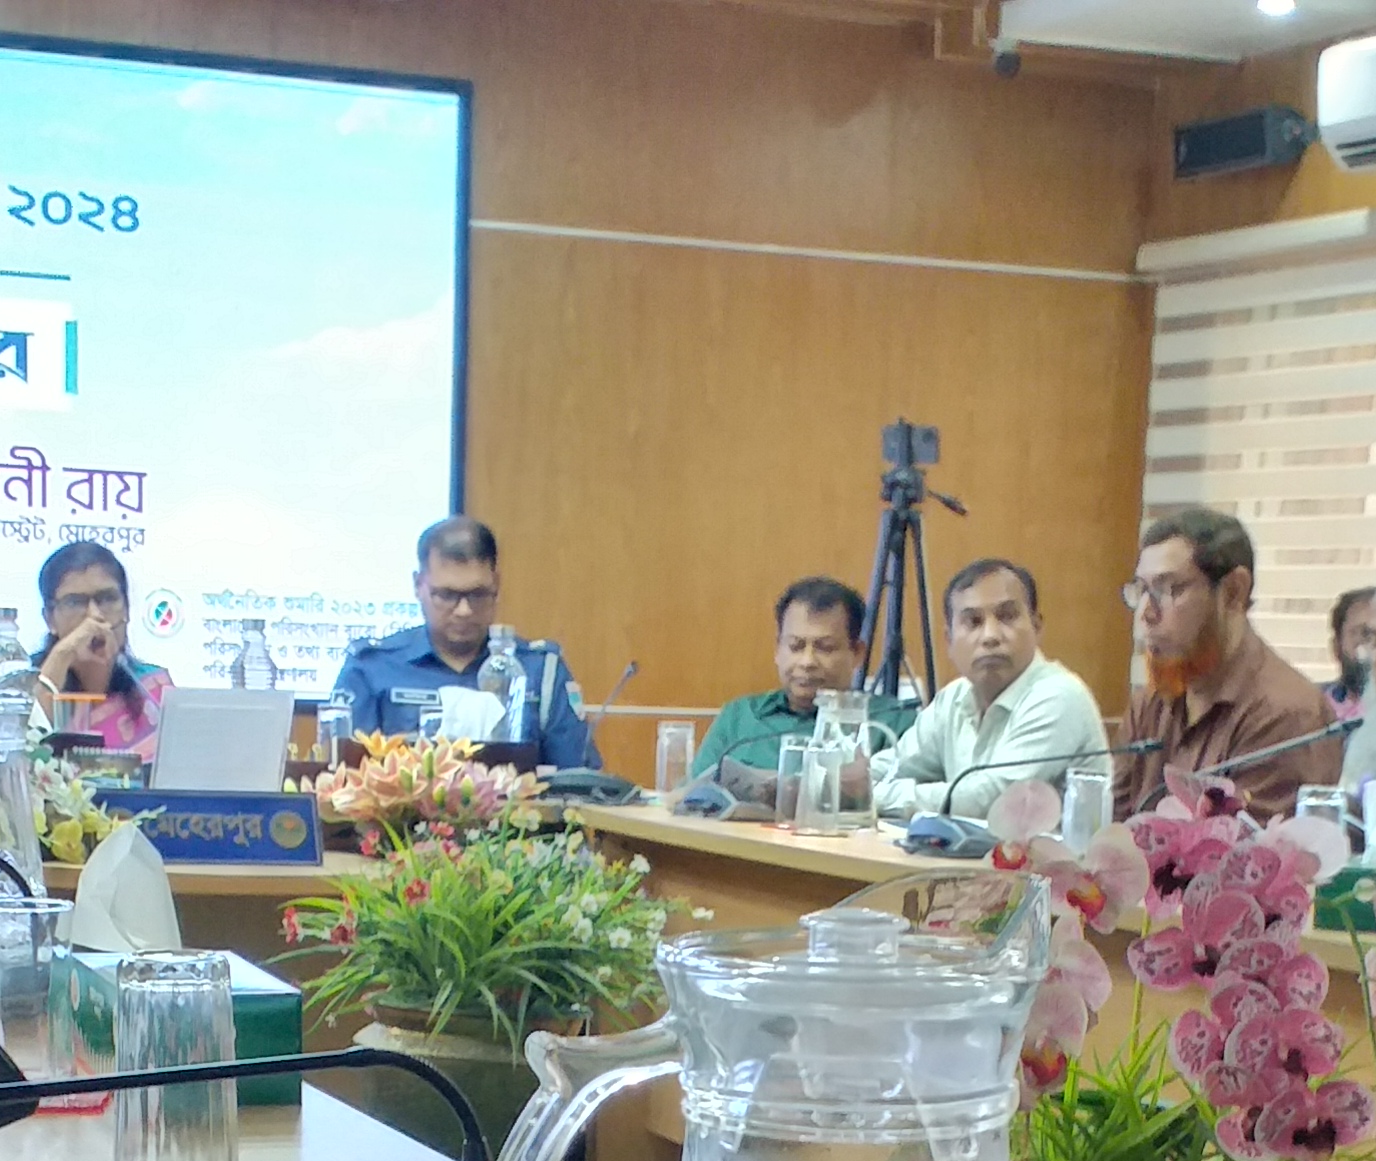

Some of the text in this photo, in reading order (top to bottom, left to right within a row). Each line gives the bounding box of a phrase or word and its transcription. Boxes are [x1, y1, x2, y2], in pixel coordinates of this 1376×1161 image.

[7, 185, 141, 234] ২০২৪
[62, 466, 147, 520] রায়
[143, 811, 264, 847] মেহেরপুর
